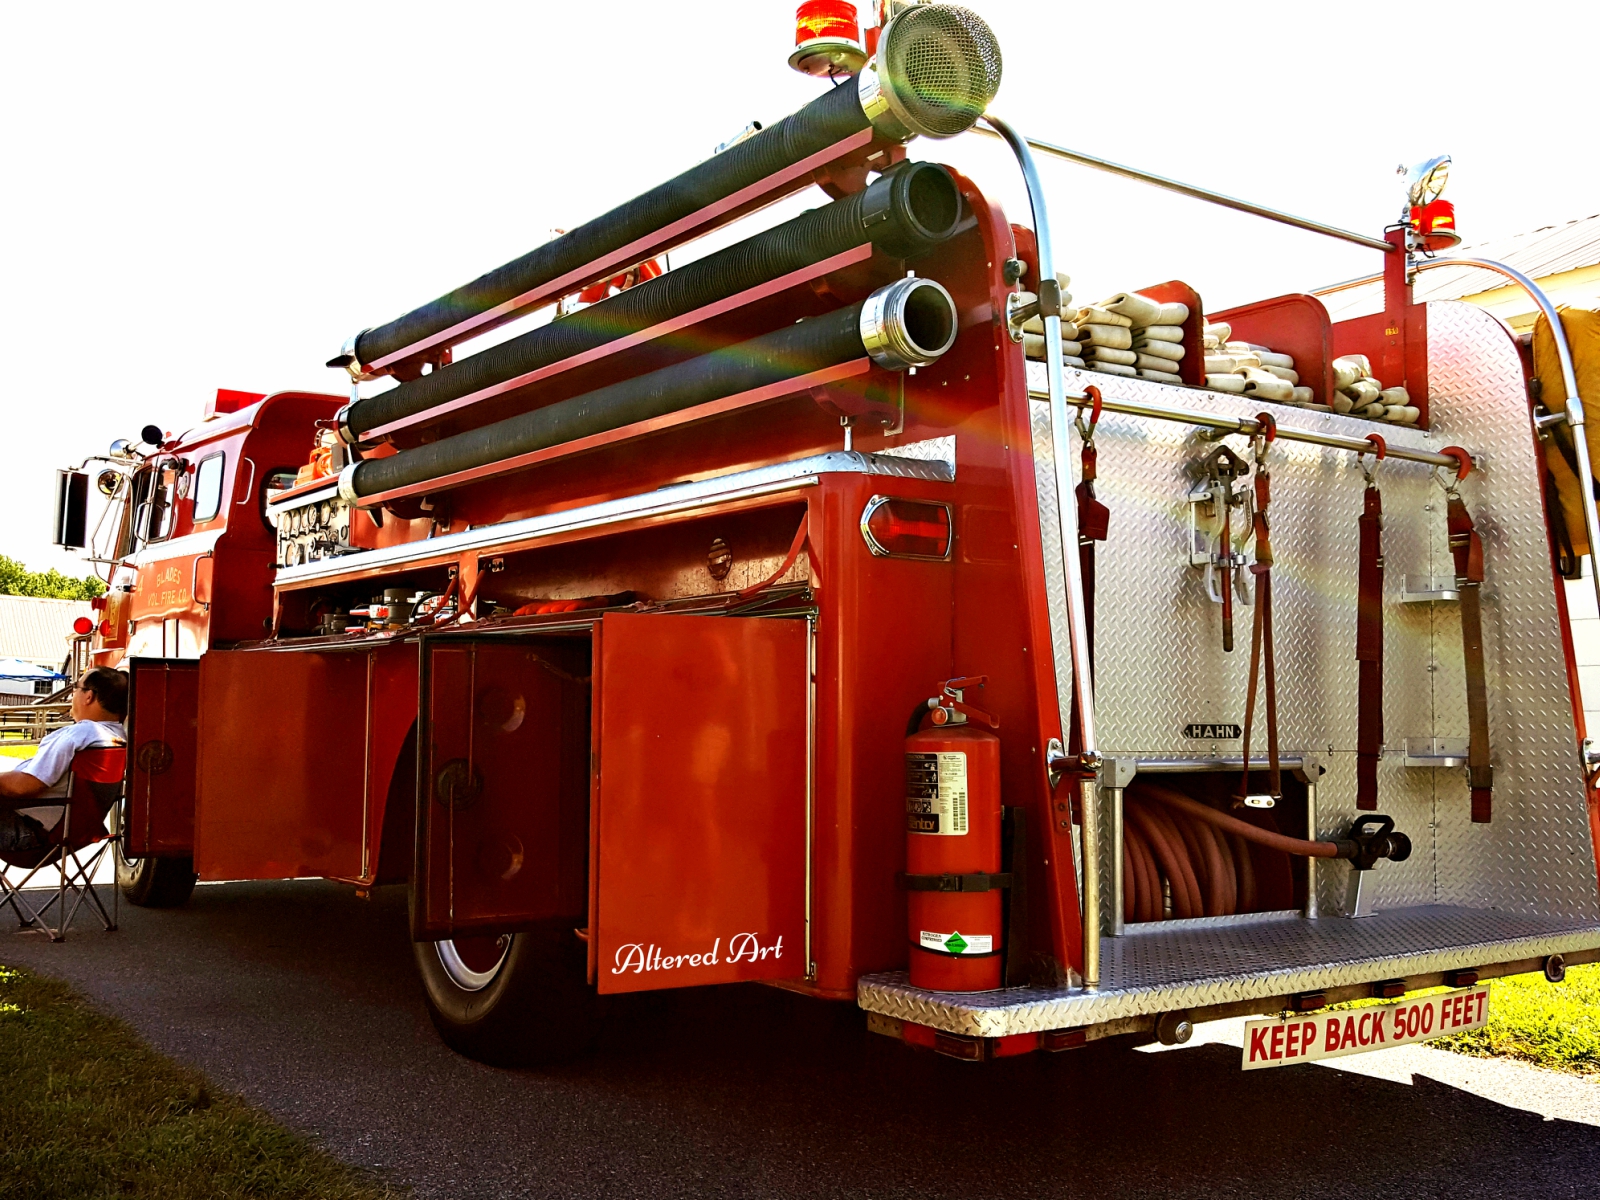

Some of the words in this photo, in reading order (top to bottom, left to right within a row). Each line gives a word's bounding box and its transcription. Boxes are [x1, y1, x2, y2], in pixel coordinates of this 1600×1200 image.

[156, 566, 182, 588] BLADES
[160, 589, 176, 606] FIRE
[1192, 725, 1234, 738] HAHN
[1249, 1021, 1318, 1063] KEEP
[1324, 1010, 1387, 1053] BACK
[1392, 1002, 1434, 1041] 500
[1440, 991, 1488, 1031] FEET
